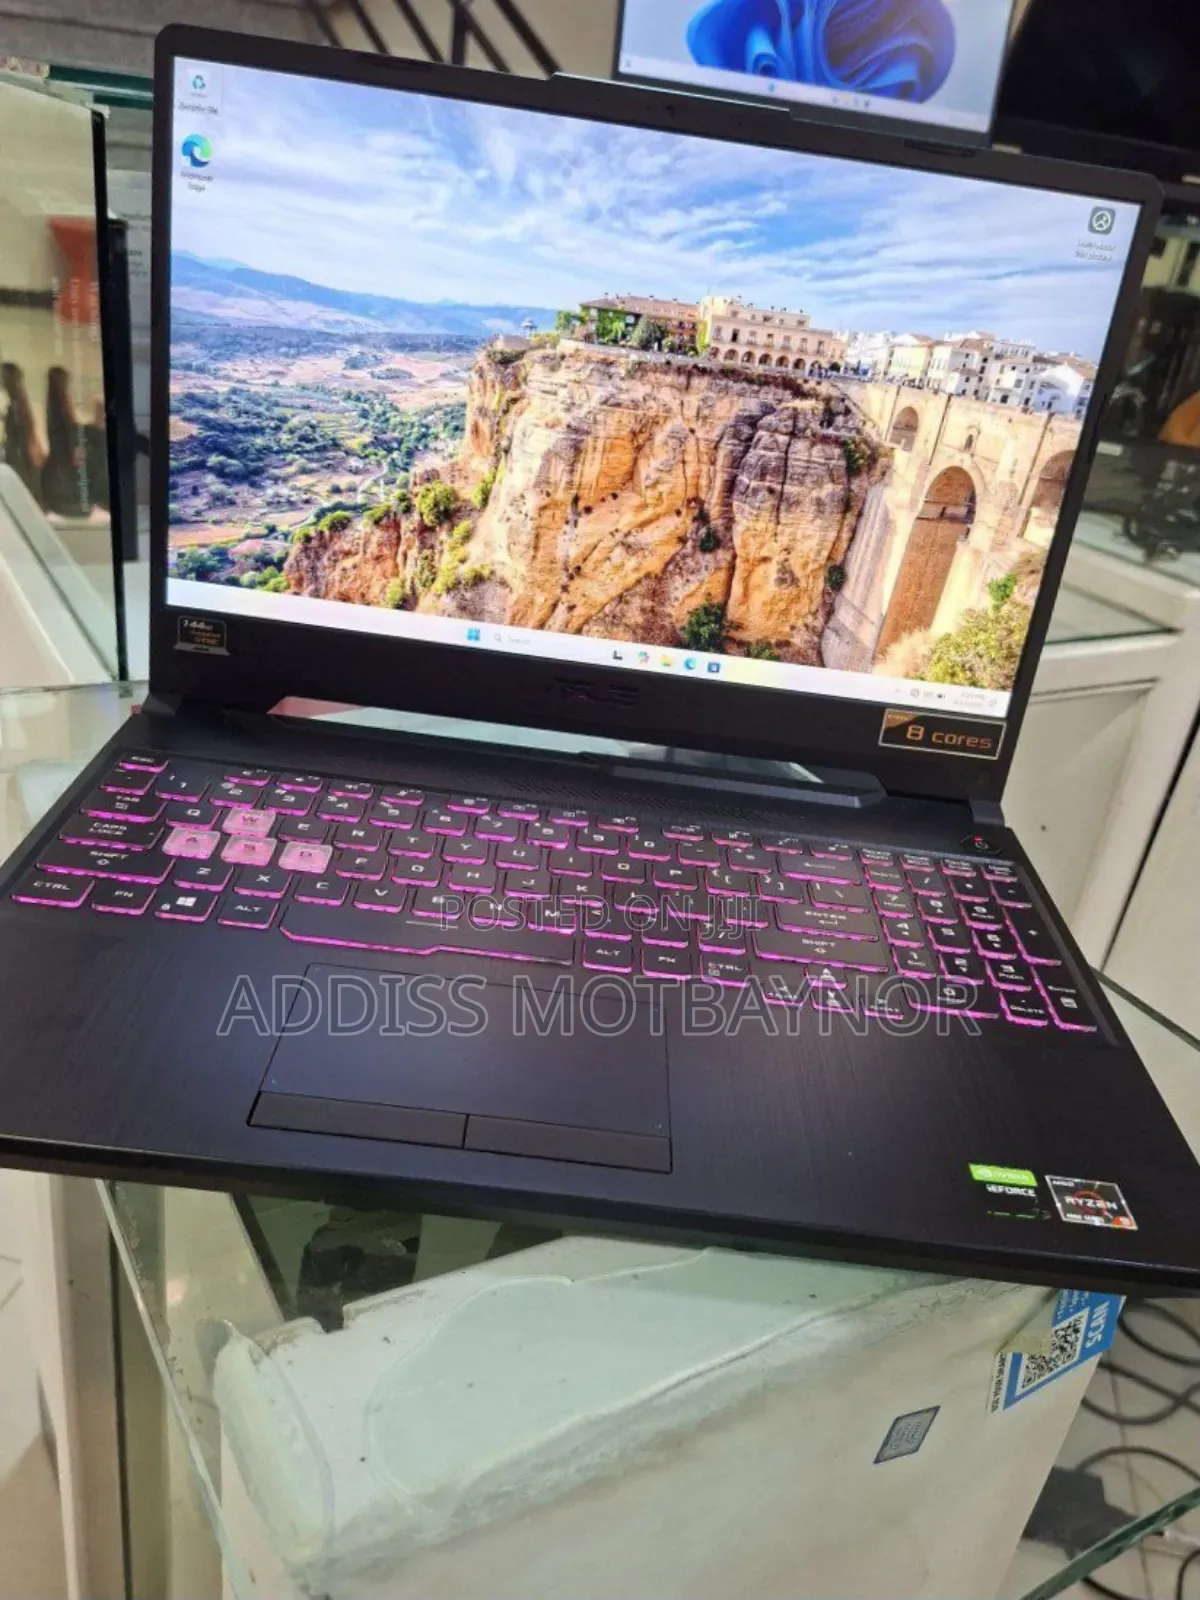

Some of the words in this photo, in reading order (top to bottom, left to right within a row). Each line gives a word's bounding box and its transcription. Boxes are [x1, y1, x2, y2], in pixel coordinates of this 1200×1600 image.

[906, 724, 926, 741] 8
[931, 731, 992, 750] cores
[461, 842, 472, 850] Y
[90, 850, 129, 860] SHIFT
[197, 867, 212, 876] Z
[256, 873, 272, 883] X
[33, 881, 72, 892] CTRL
[316, 881, 330, 890] C
[115, 890, 134, 898] FN
[375, 888, 389, 897] V
[235, 903, 262, 914] ALT
[804, 910, 847, 920] ENTER
[801, 938, 837, 948] SHIFT
[596, 949, 622, 957] ALT
[708, 961, 743, 971] CTRL
[1064, 1195, 1118, 1210] RYZEN
